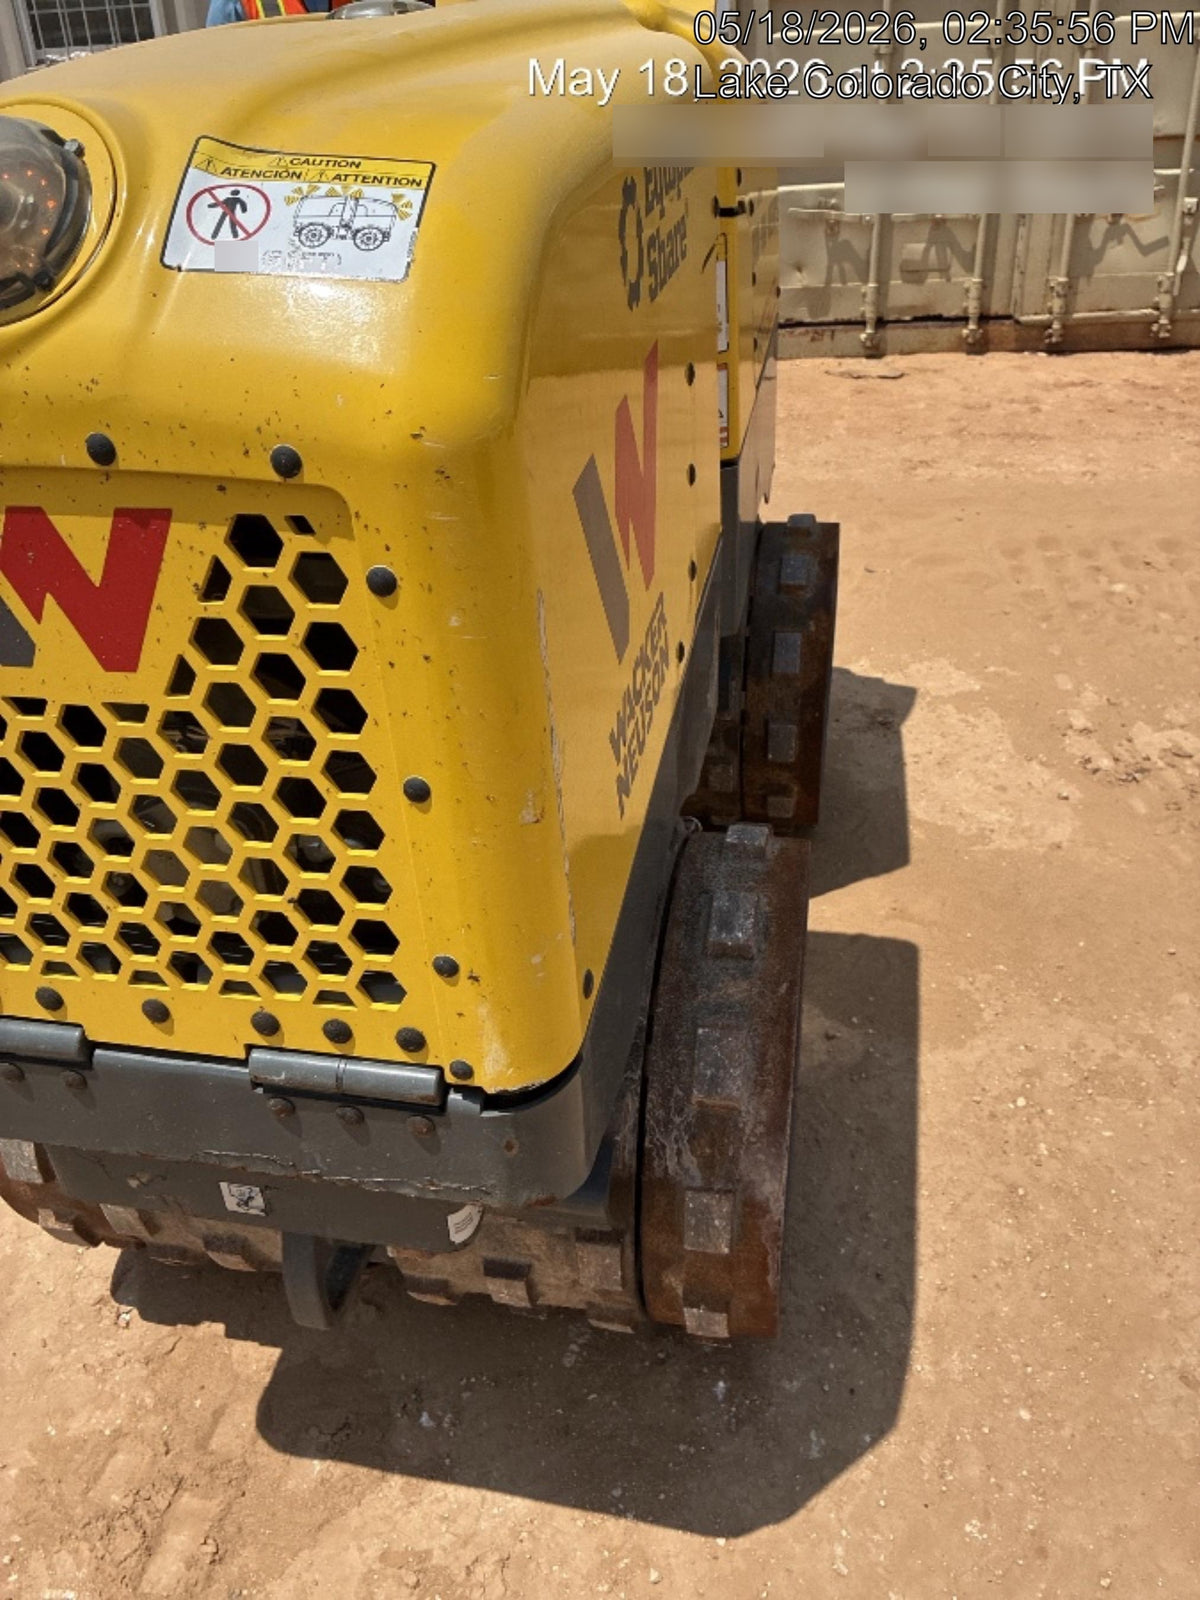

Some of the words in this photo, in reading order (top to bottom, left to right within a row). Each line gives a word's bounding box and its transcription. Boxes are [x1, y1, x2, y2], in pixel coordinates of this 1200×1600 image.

[288, 157, 362, 169] CAUTION
[331, 173, 423, 188] ATTENTION
[647, 214, 687, 304] Share
[608, 591, 668, 767] WACKER
[616, 628, 670, 821] NEUSON
